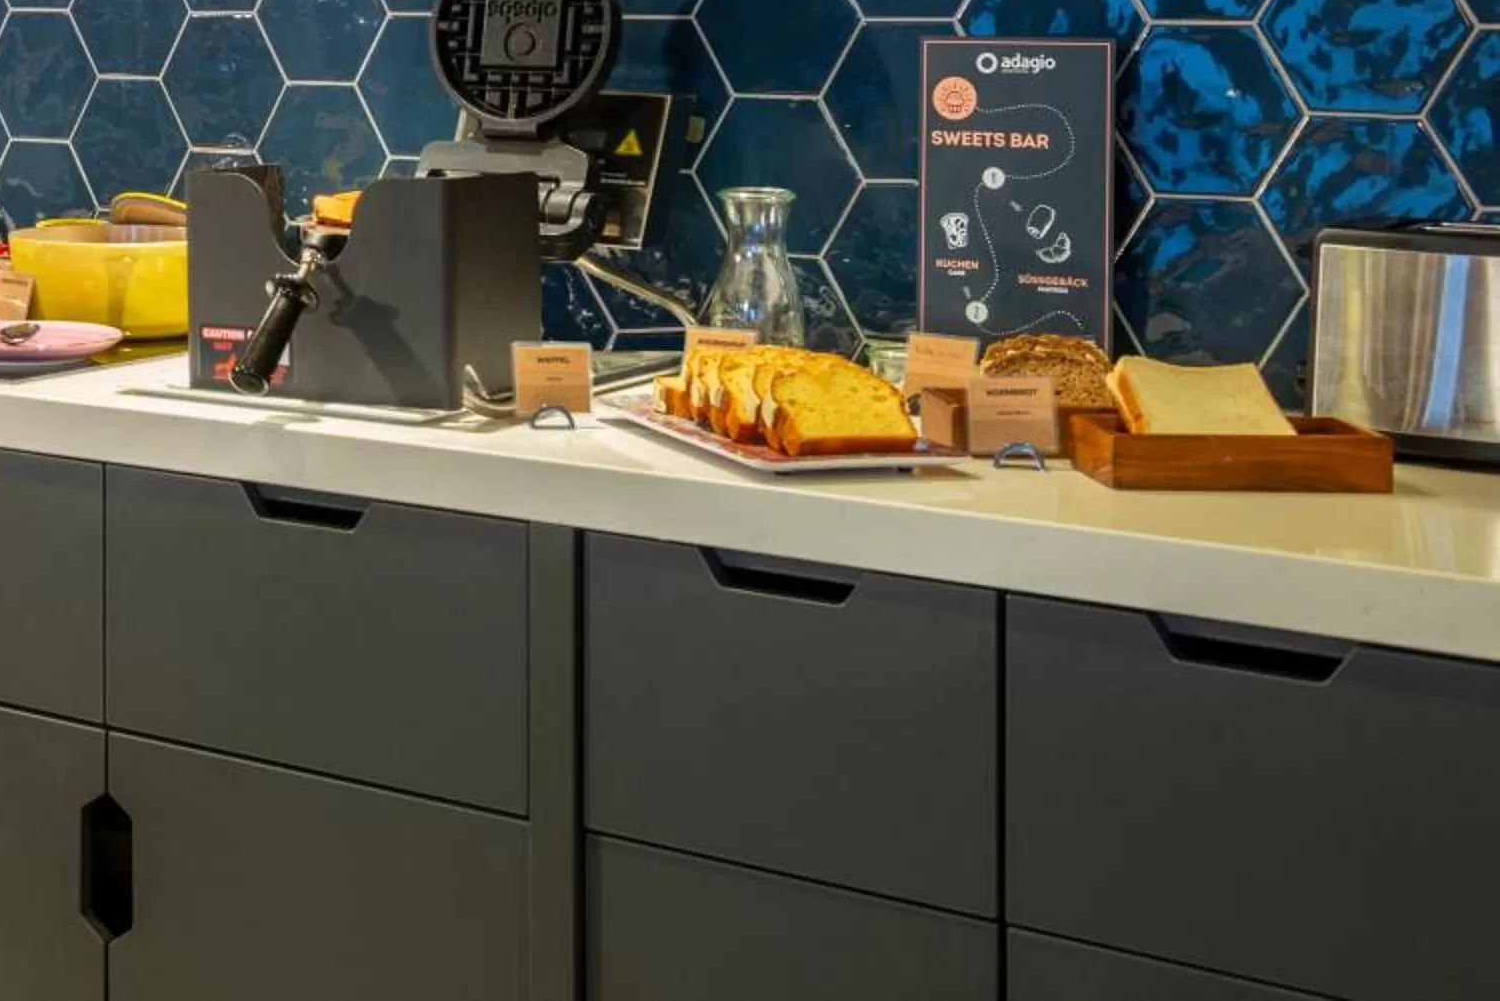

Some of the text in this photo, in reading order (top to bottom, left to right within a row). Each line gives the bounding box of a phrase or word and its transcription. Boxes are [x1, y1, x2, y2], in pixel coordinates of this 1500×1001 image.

[1001, 53, 1056, 74] adagio
[931, 130, 1049, 150] SWEETS BAR
[935, 258, 979, 270] KUCHEN
[202, 327, 245, 341] CAUTION
